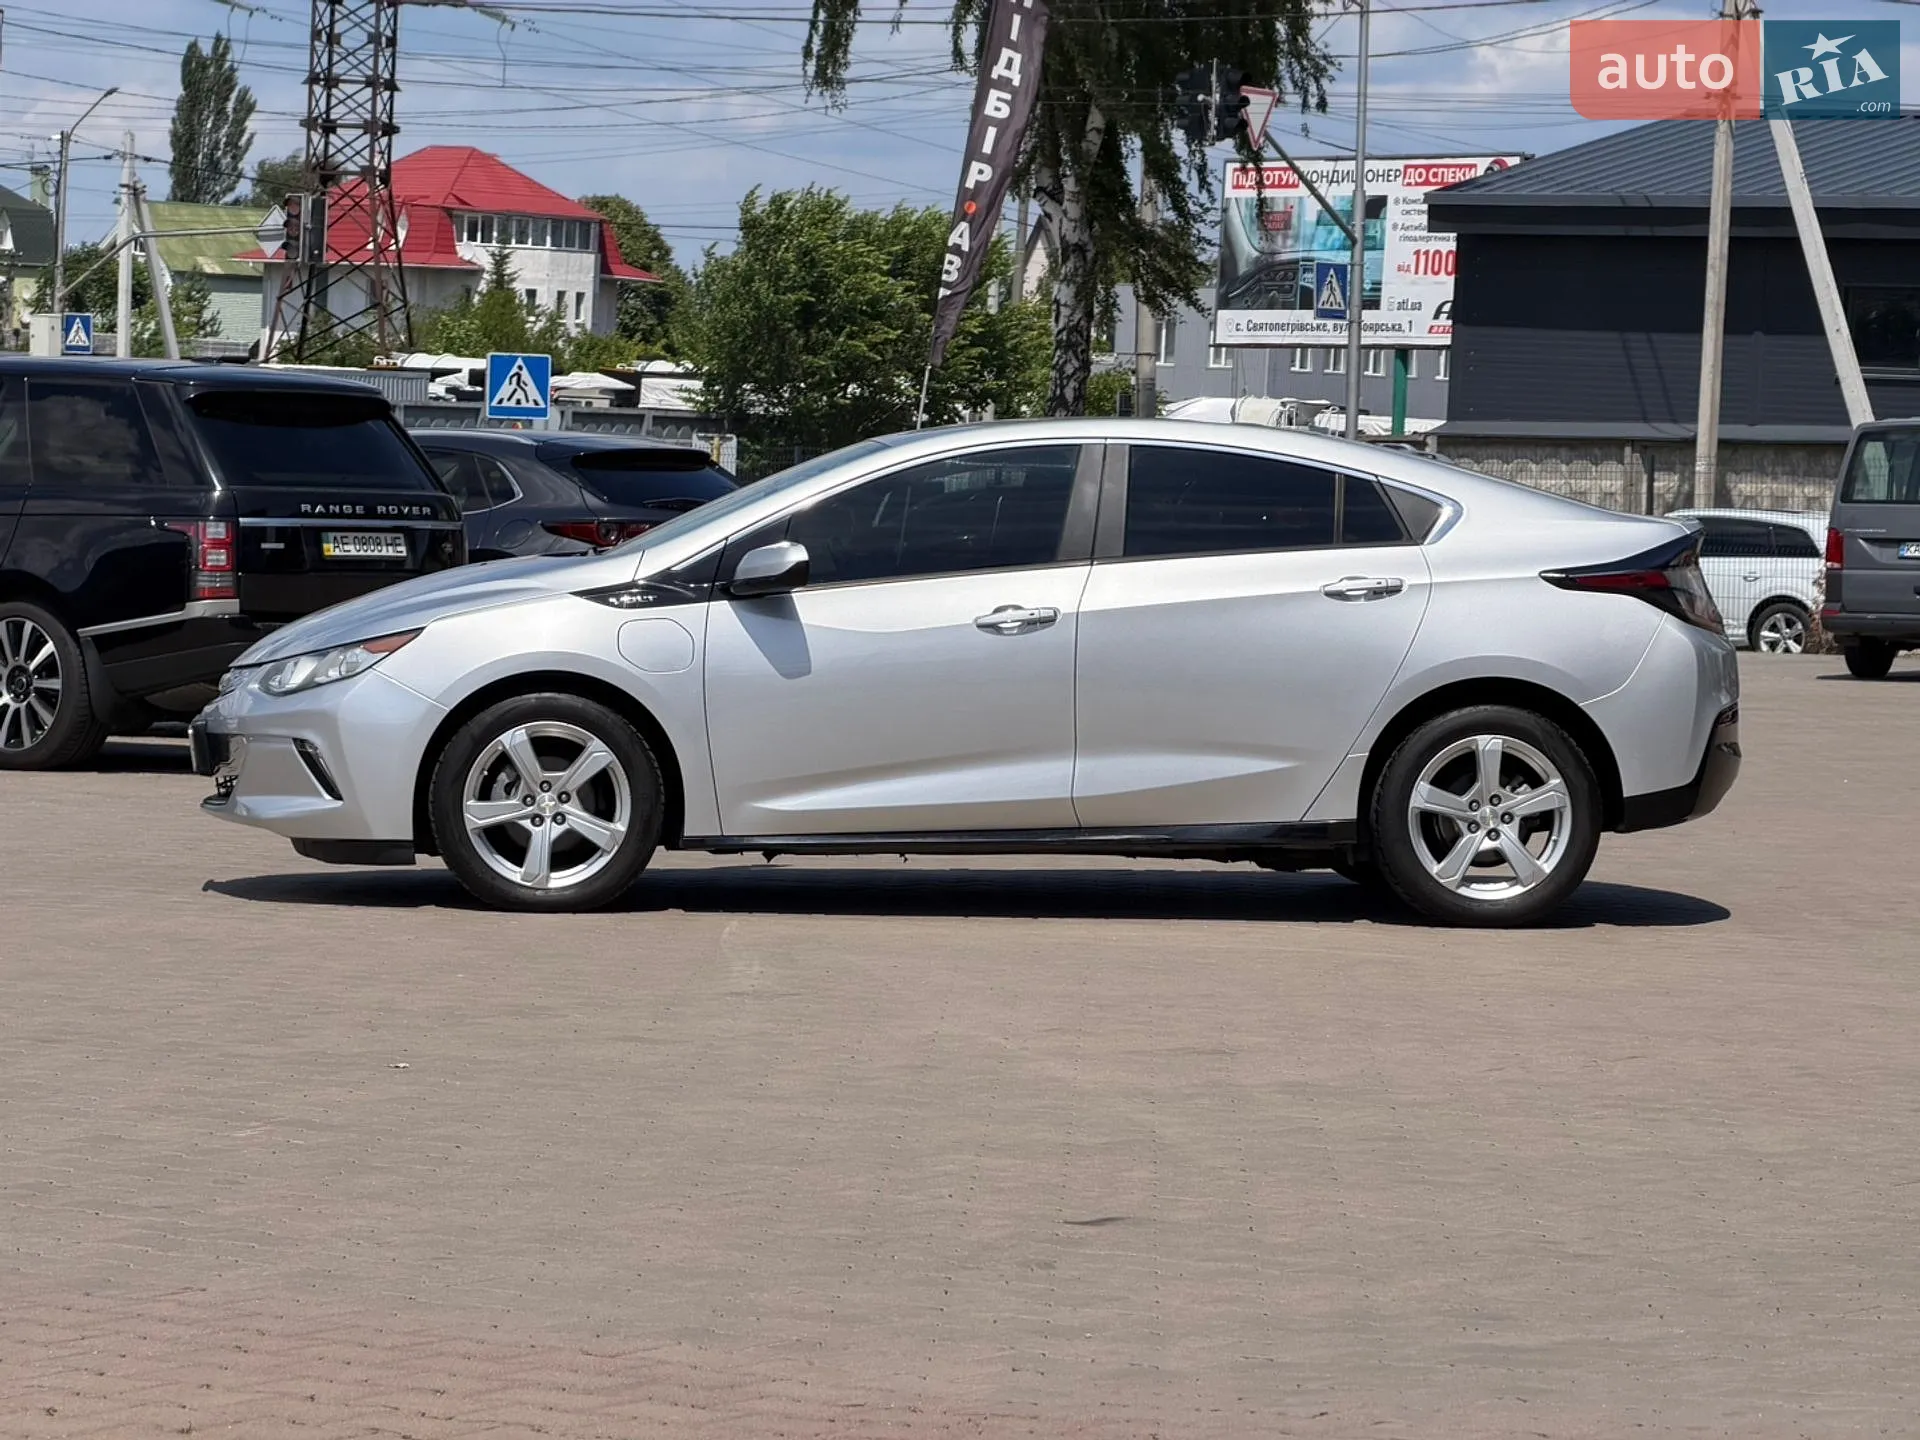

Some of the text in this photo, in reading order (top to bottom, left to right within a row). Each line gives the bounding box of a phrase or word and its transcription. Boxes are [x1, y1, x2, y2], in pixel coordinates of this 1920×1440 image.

[965, 0, 1034, 189] ІДБІР
[1233, 167, 1476, 187] ПІДОТУЙ ОНДИЦОНЕР ДО СПЕКИ
[1397, 249, 1457, 276] від 1100
[1396, 298, 1423, 311] atl.ua
[1361, 322, 1405, 334] оярська,
[1408, 320, 1413, 332] 1
[301, 504, 432, 516] RANGE ROVER
[333, 535, 351, 553] AE
